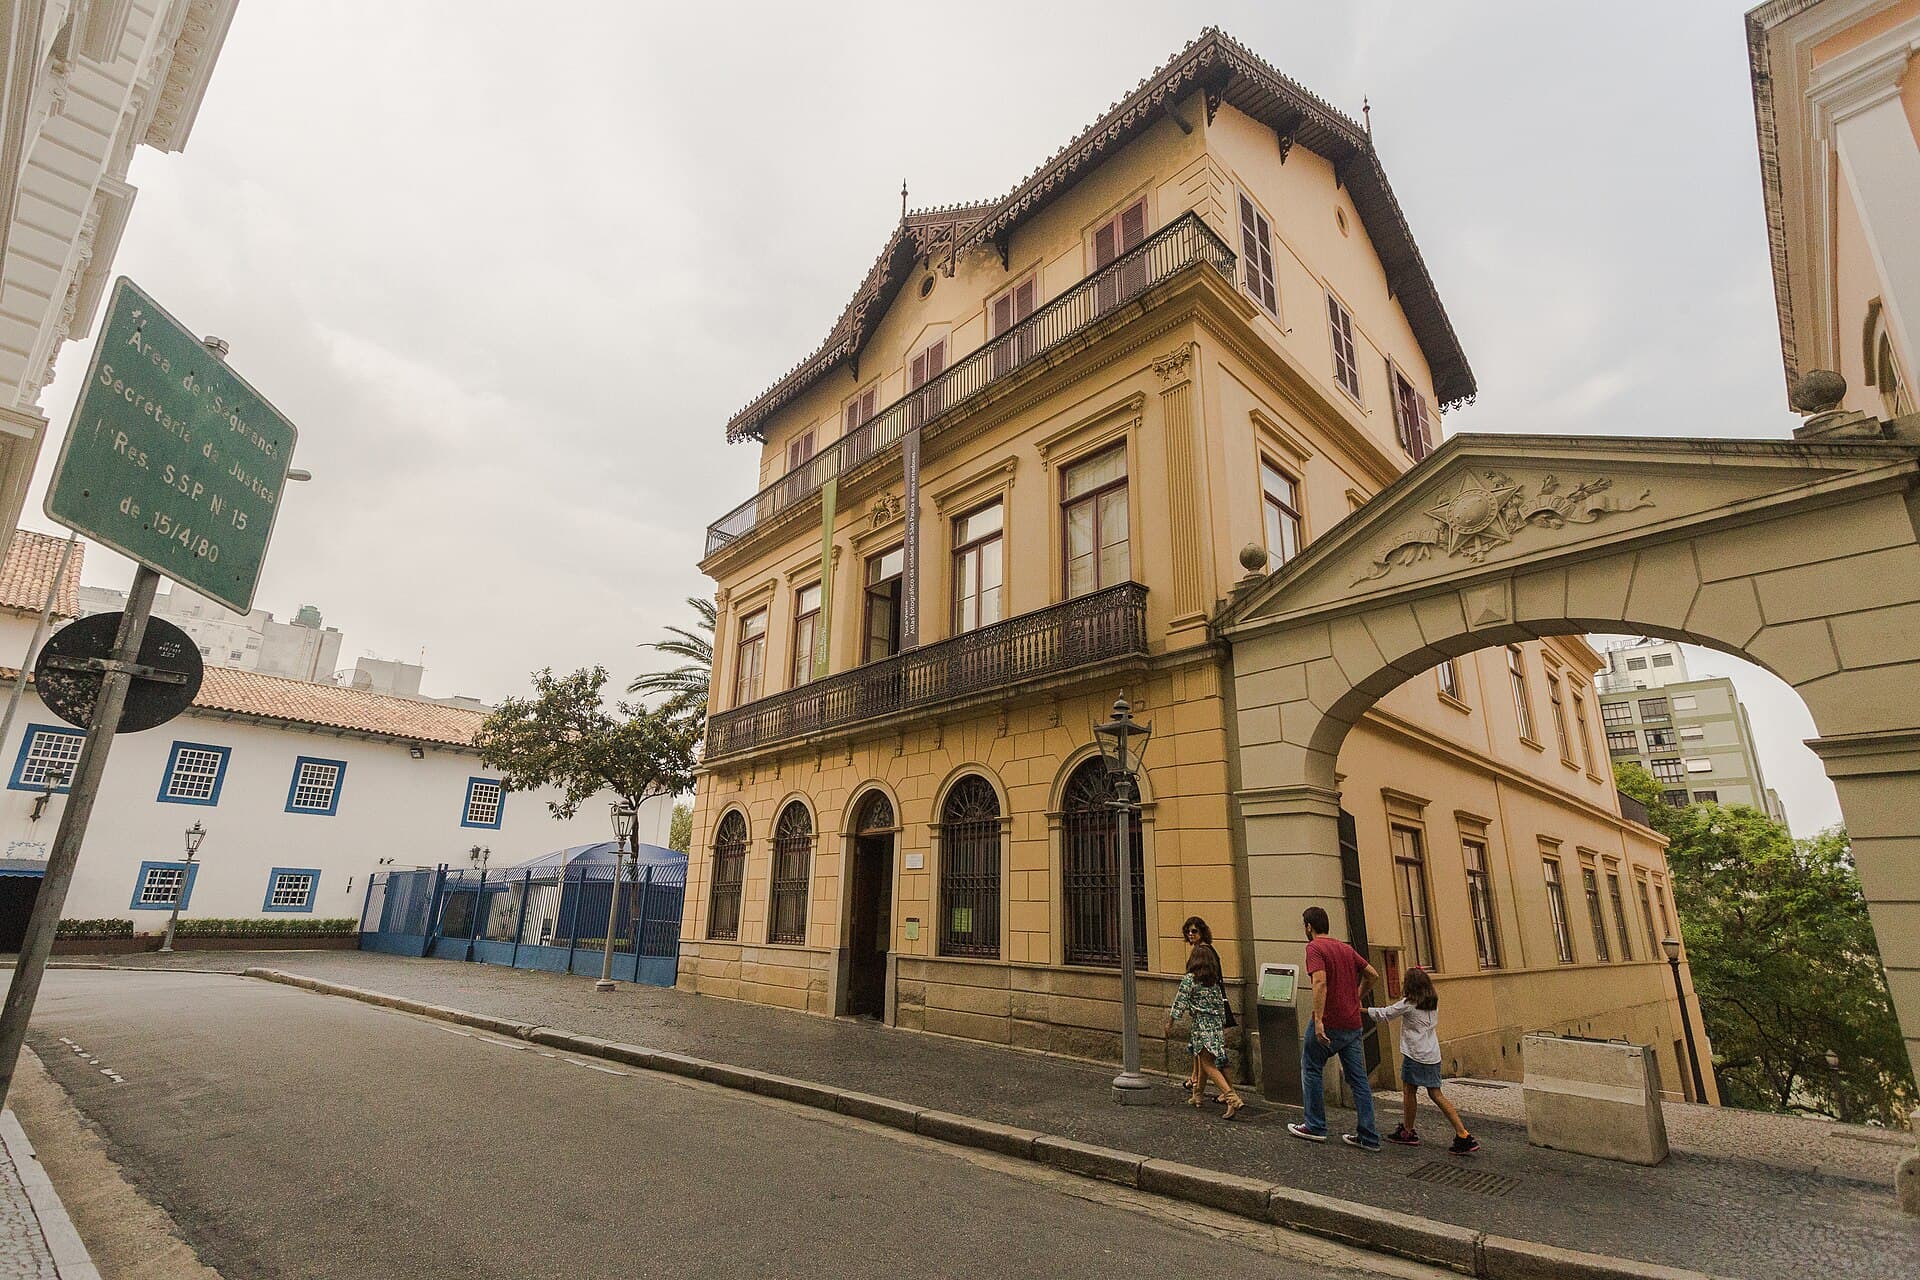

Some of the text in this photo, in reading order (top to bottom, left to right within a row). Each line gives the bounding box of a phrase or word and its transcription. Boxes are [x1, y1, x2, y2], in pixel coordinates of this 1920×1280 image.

[182, 374, 201, 397] de
[114, 431, 149, 470] Res.
[232, 509, 248, 530] 15
[120, 496, 219, 563] de 15/4/80
